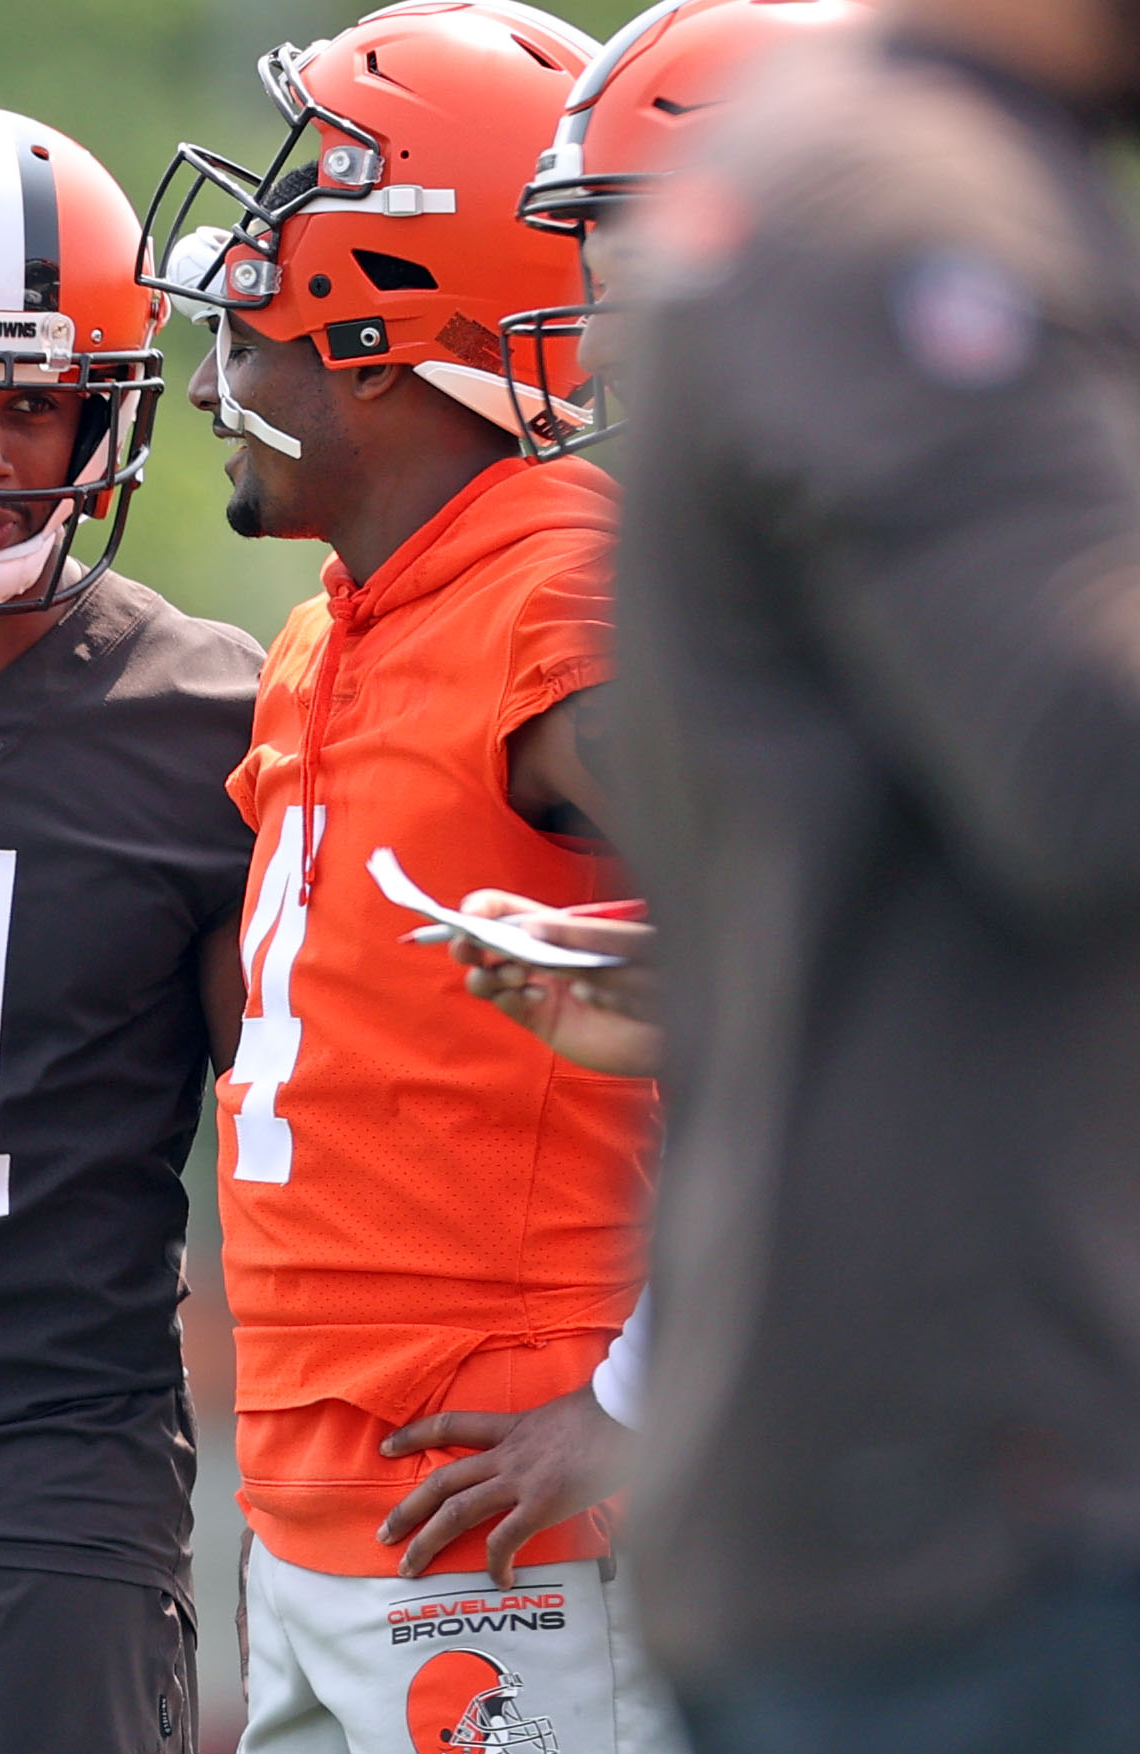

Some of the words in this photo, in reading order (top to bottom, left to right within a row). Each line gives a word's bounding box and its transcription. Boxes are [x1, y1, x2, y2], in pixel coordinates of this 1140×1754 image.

[229, 805, 326, 1188] 4
[387, 1593, 565, 1625] CLEVELAND
[391, 1611, 565, 1645] BROWNS
